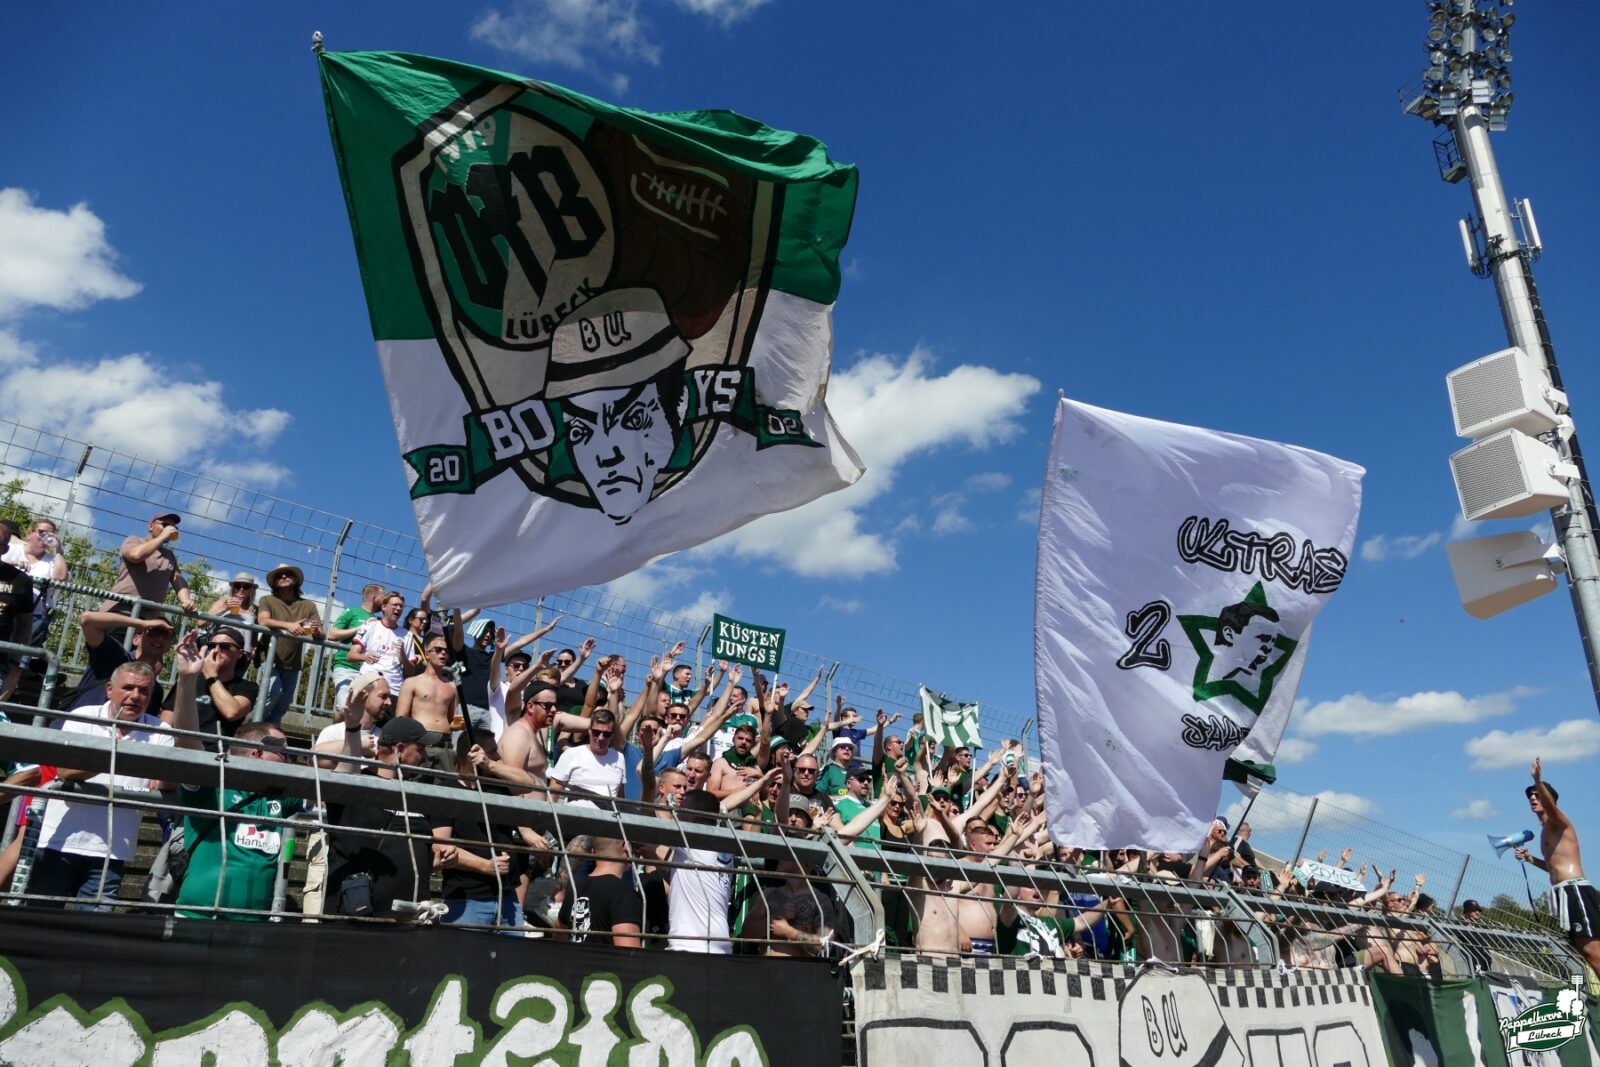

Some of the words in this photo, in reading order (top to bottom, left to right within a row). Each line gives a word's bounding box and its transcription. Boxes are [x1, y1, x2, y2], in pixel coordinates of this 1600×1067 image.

[578, 310, 632, 352] BU
[430, 455, 460, 482] 20
[1177, 516, 1348, 595] ULTRAS
[716, 638, 767, 664] JUNGS
[719, 620, 780, 648] KÜSTEN
[1116, 600, 1172, 670] 2
[1140, 990, 1188, 1058] BU
